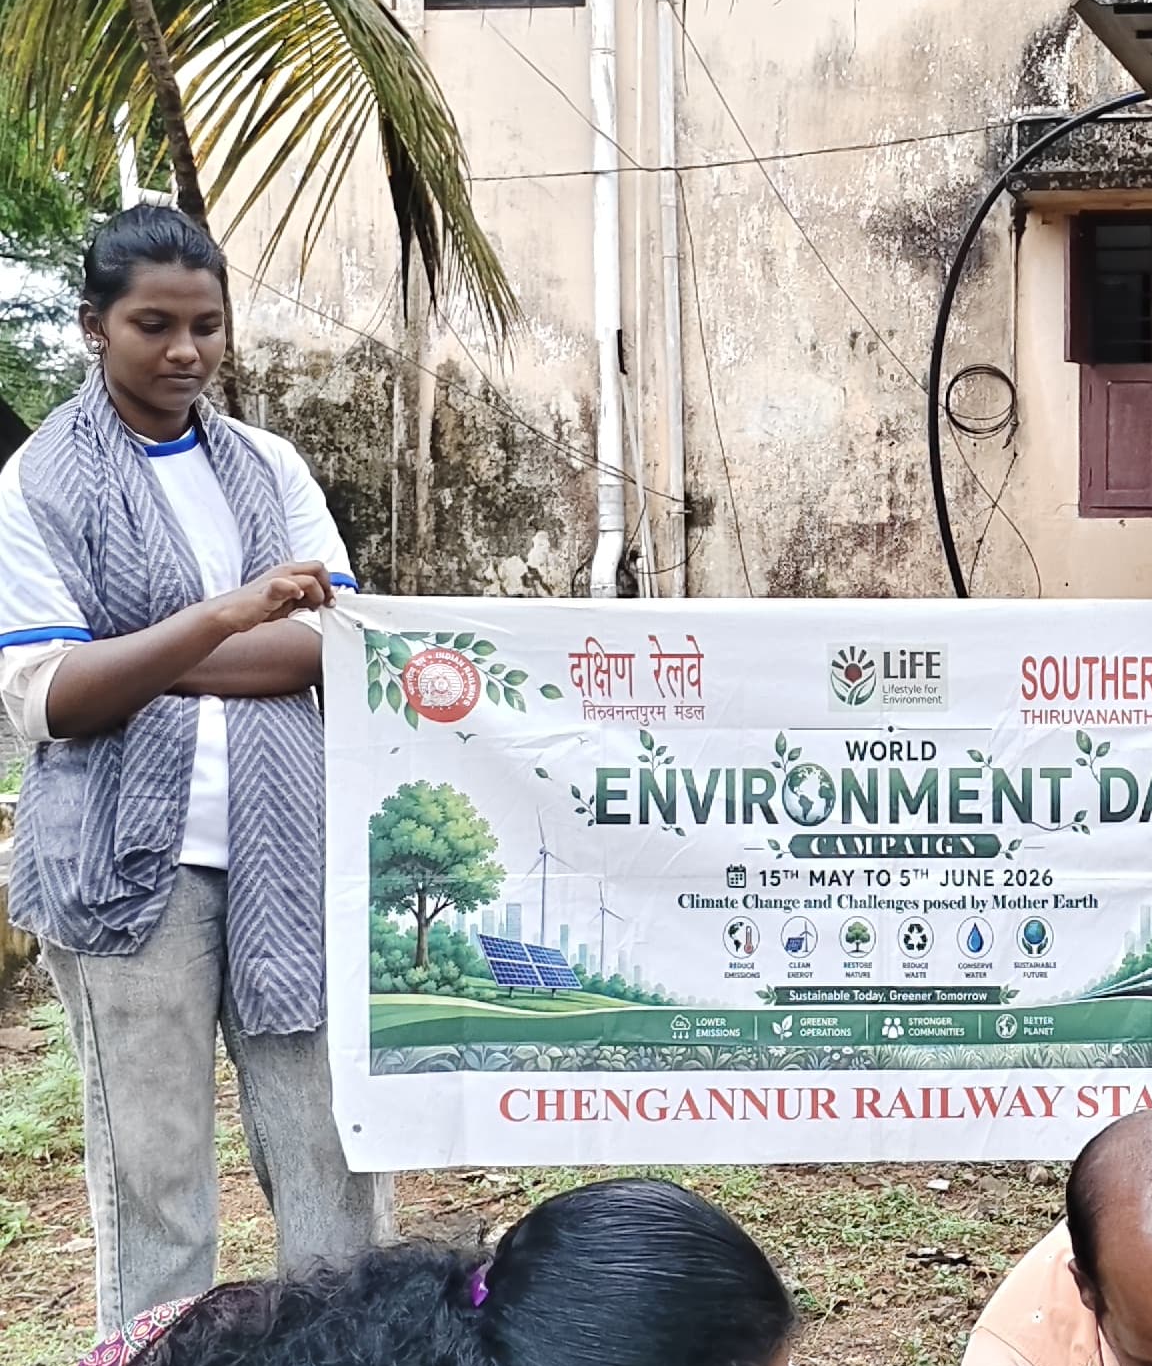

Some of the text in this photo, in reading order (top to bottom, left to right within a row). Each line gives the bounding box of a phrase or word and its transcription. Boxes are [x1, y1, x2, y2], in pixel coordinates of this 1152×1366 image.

[435, 651, 466, 668] INDIAN
[883, 649, 941, 679] LiFE
[568, 635, 704, 698] दक्षिण रेलवे
[882, 684, 938, 695] Lifestyle for
[882, 694, 942, 704] Environment
[673, 700, 706, 721] मंडल
[845, 740, 937, 762] WORLD
[596, 763, 1072, 826] ENVIRONMENT
[809, 836, 977, 855] CAMPAIGN
[809, 870, 855, 886] MAY
[867, 870, 891, 886] TO
[939, 870, 994, 886] JUNE
[1003, 869, 1053, 886] 2026
[678, 893, 1099, 915] Climate Change and Challenges posed by Mother Earth
[788, 961, 811, 970] CLEAN
[845, 971, 871, 979] NATURE
[964, 971, 987, 979] WATER
[789, 989, 988, 1003] Sustainable Today, Greener Tomorrow
[695, 1017, 727, 1027] LOWER
[799, 1017, 838, 1027] GREENER
[908, 1016, 953, 1026] STRONGER
[1023, 1016, 1054, 1026] BETTER
[695, 1028, 741, 1038] EMISSIONS
[799, 1028, 852, 1037] OPERATIONS
[908, 1027, 965, 1037] COMMUNITIES
[1023, 1027, 1055, 1036] PLANET
[499, 1087, 840, 1122] CHENGANNUR
[851, 1085, 1065, 1120] RAILWAY
